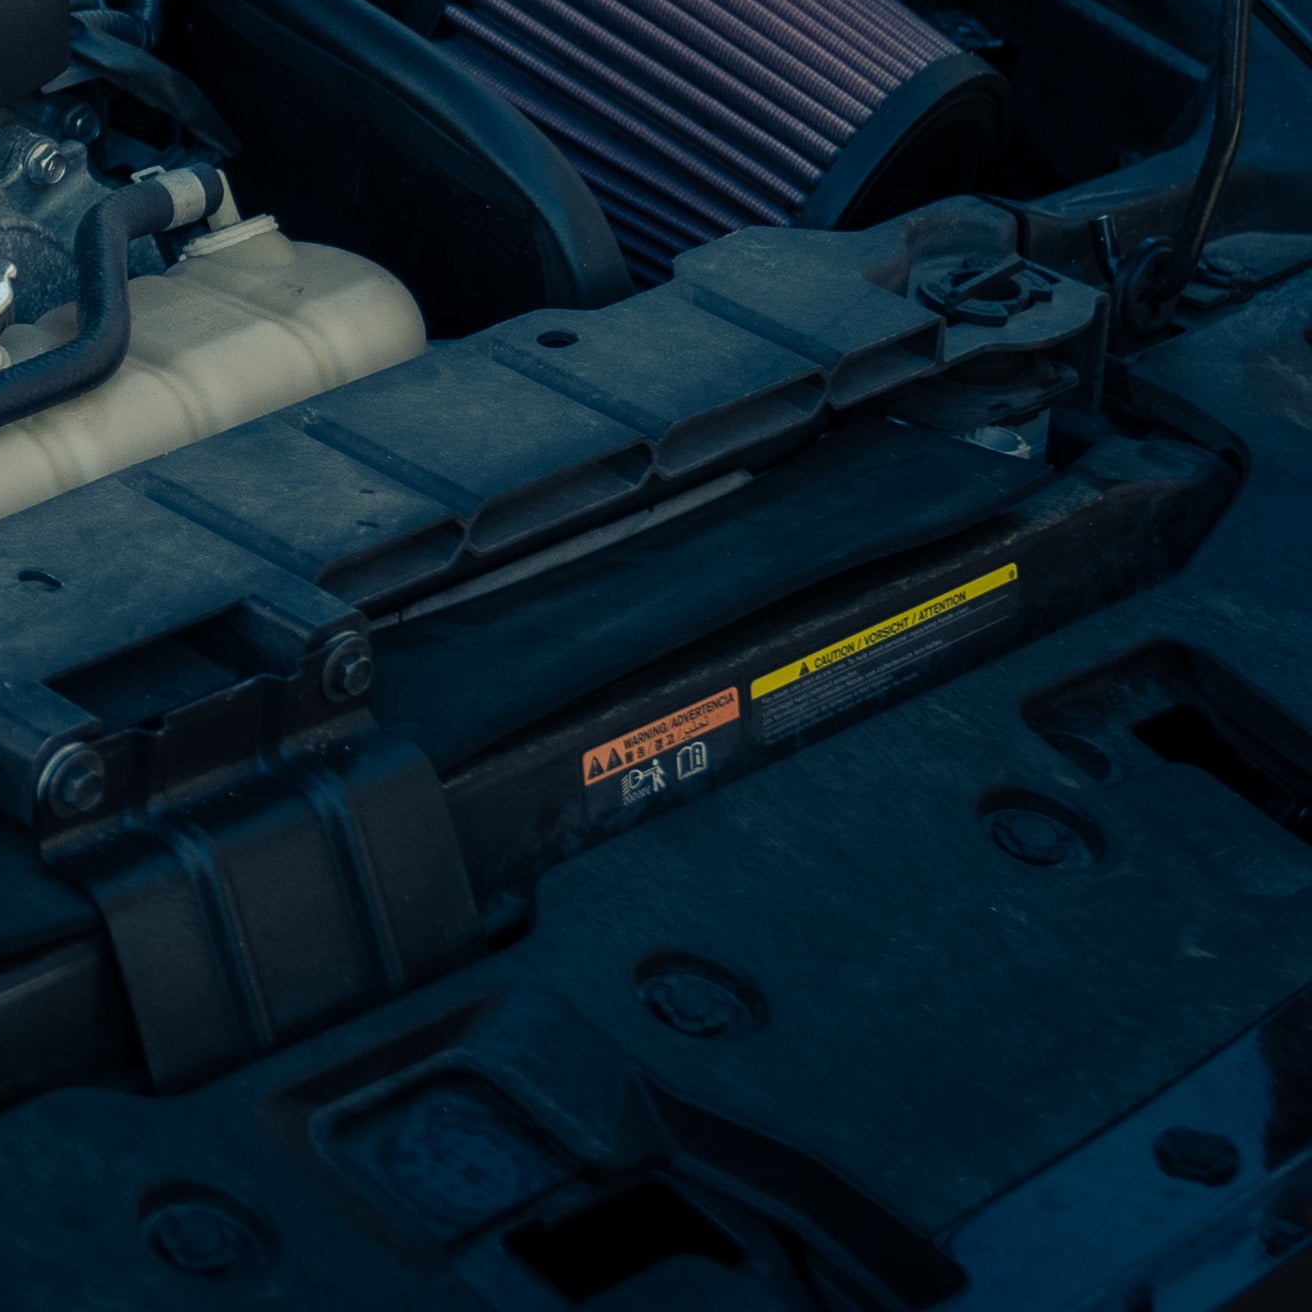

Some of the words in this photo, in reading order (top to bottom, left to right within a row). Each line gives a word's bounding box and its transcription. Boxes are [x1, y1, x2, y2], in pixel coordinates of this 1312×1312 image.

[813, 643, 855, 669] CAUTION
[864, 619, 910, 647] VORSICHT
[918, 590, 967, 622] ATTENTION
